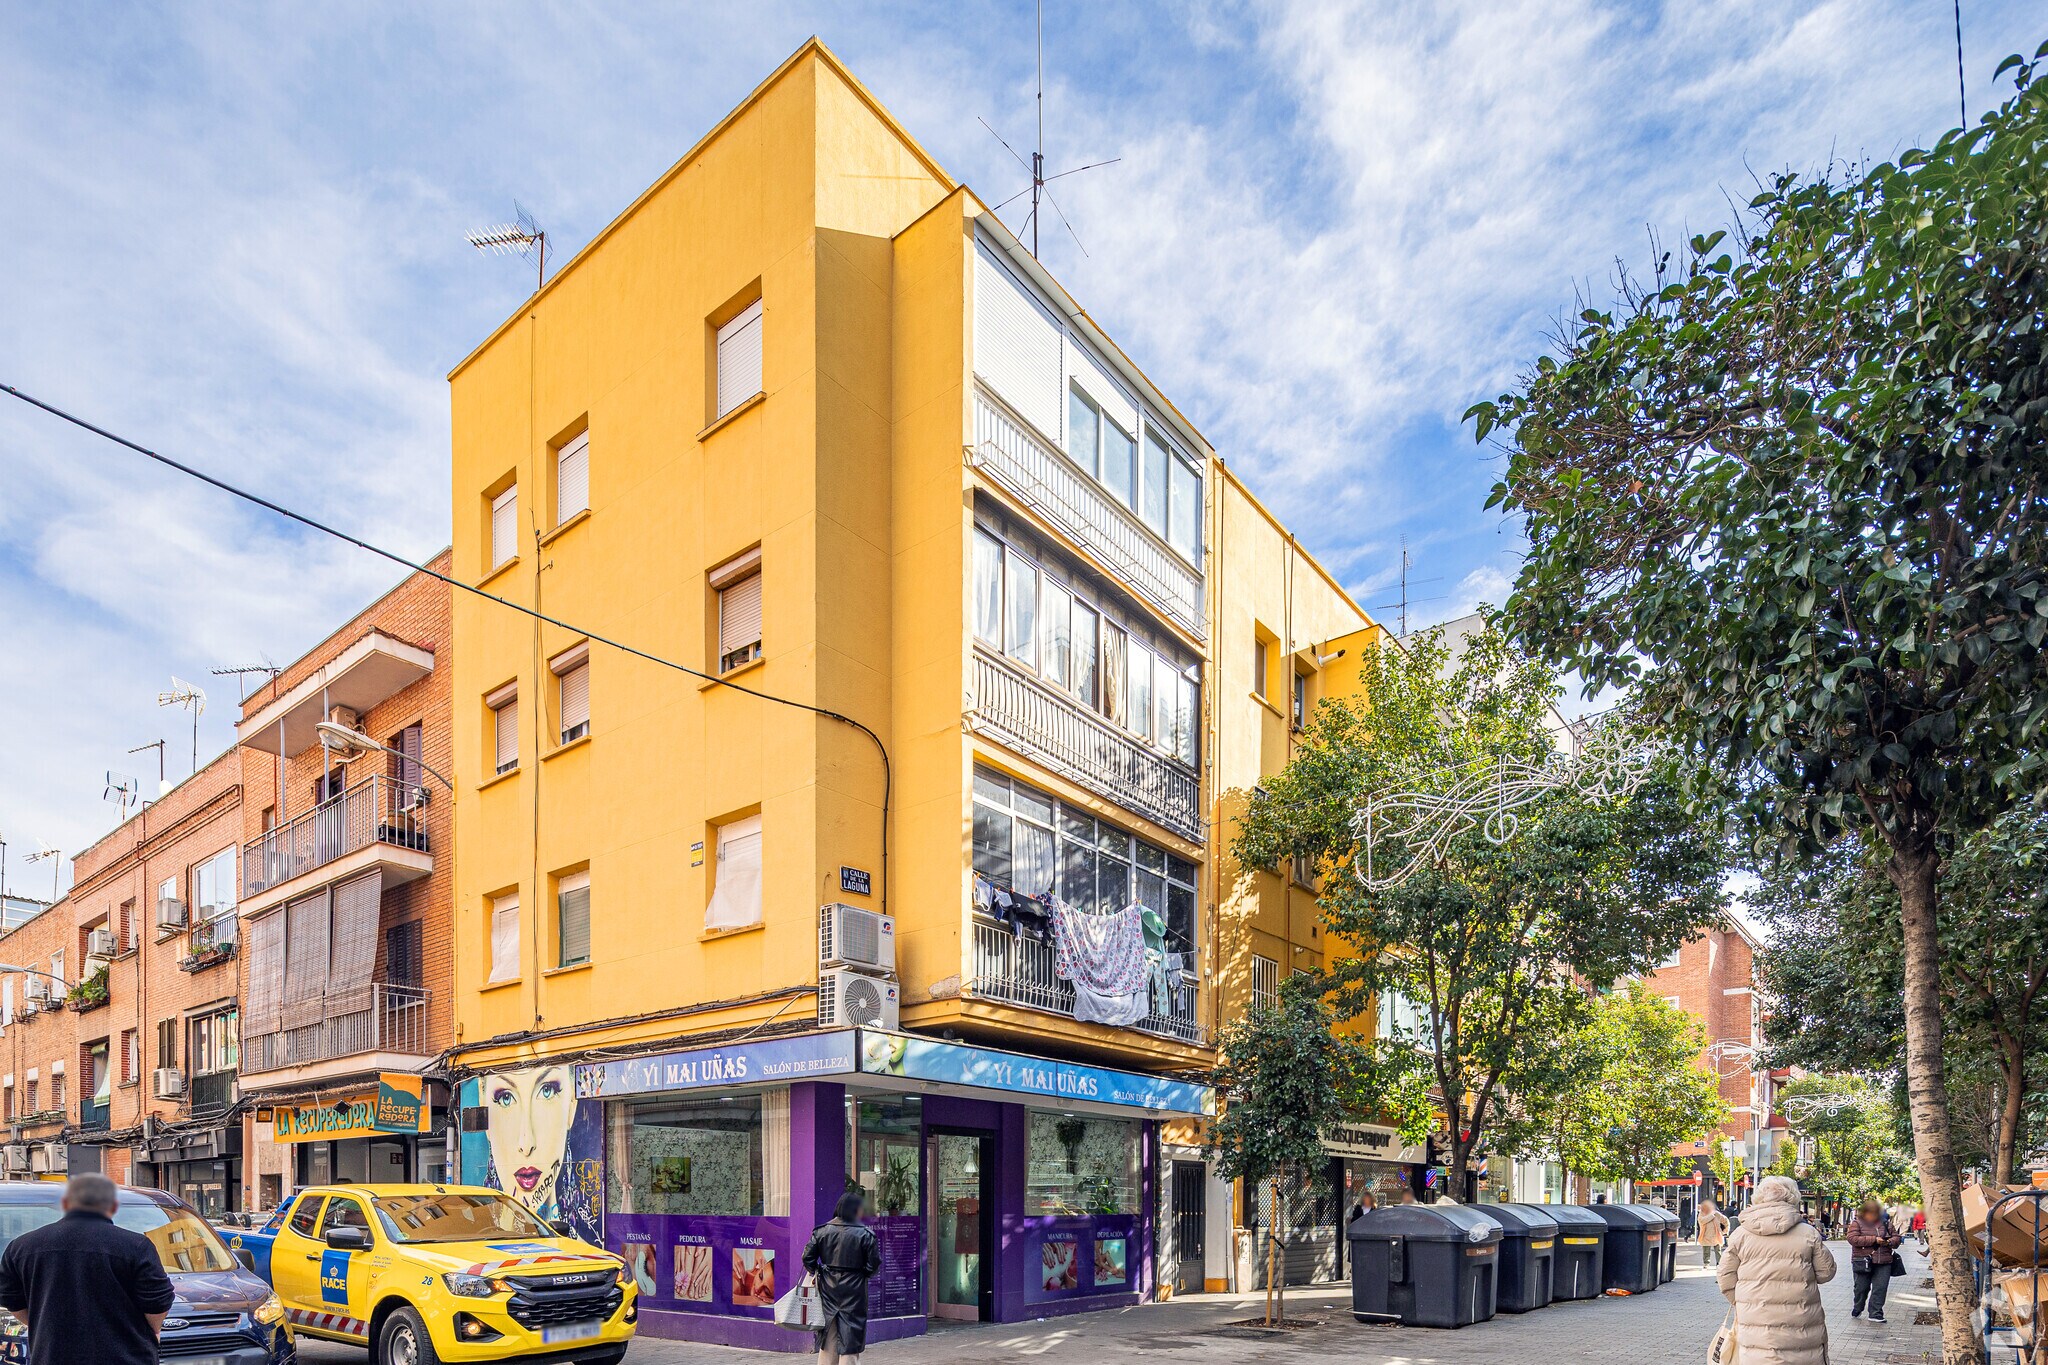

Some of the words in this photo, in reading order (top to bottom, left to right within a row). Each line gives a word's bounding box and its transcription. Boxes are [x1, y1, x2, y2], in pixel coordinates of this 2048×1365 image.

[850, 870, 868, 879] CALLE
[843, 879, 869, 894] LAGUNA
[643, 1063, 658, 1086] YI
[666, 1062, 697, 1084] MAI
[701, 1054, 747, 1080] UÑAS
[763, 1060, 791, 1075] SALÓN
[793, 1061, 806, 1072] DE
[808, 1056, 849, 1070] BELLEZA
[994, 1062, 1012, 1085] YI
[1021, 1067, 1054, 1091] MAI
[1057, 1070, 1098, 1097] UÑAS
[381, 1095, 393, 1105] LA
[1113, 1090, 1134, 1101] SALÓN
[1135, 1093, 1145, 1103] DE
[277, 1112, 290, 1136] LA
[626, 1233, 651, 1241] PESTAÑAS
[679, 1235, 706, 1243] PEDICURA
[740, 1237, 763, 1246] MASAJE
[321, 1276, 346, 1290] RACE
[421, 1275, 433, 1286] 28
[552, 1275, 588, 1285] ISUZU
